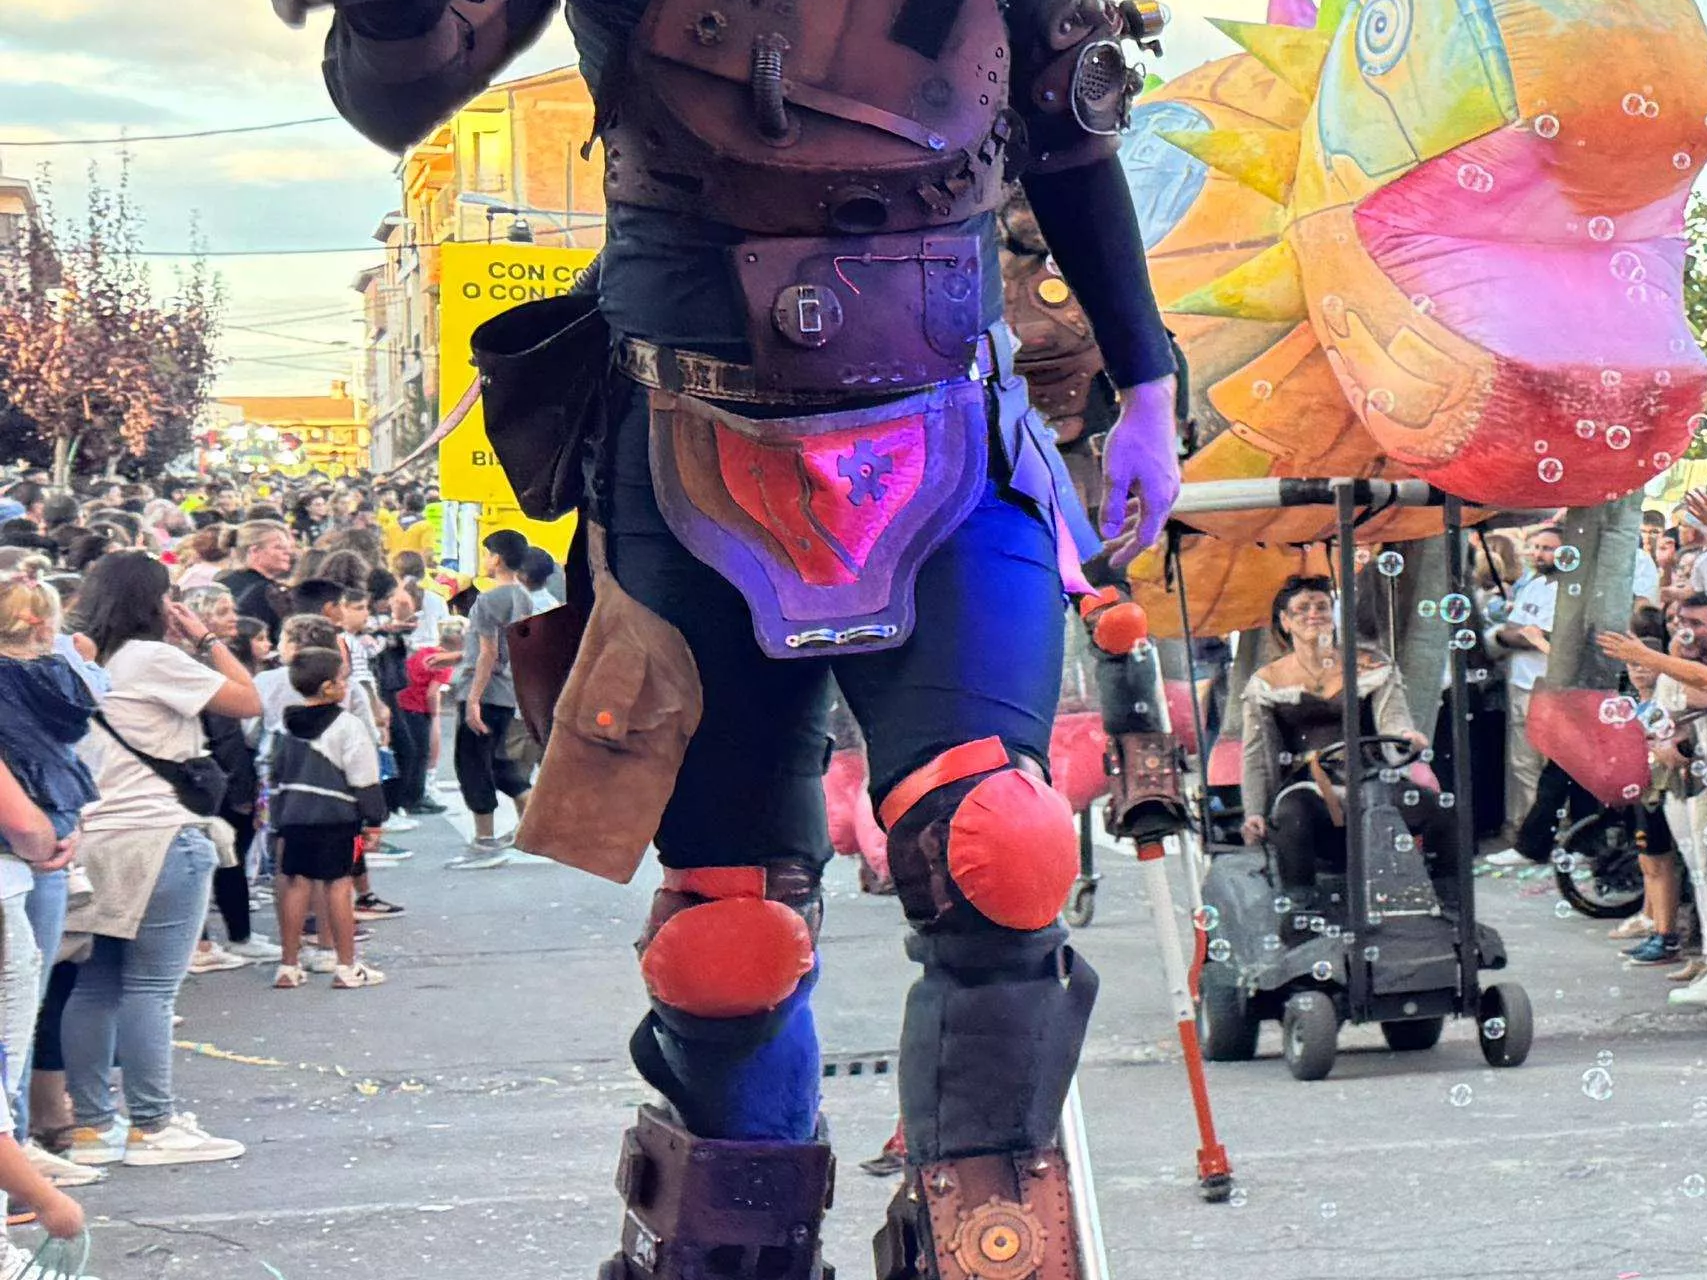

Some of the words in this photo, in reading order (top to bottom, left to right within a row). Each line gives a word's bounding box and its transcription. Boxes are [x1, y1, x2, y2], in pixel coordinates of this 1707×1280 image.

[488, 261, 545, 281] CON
[462, 282, 481, 299] O
[489, 284, 545, 301] CON
